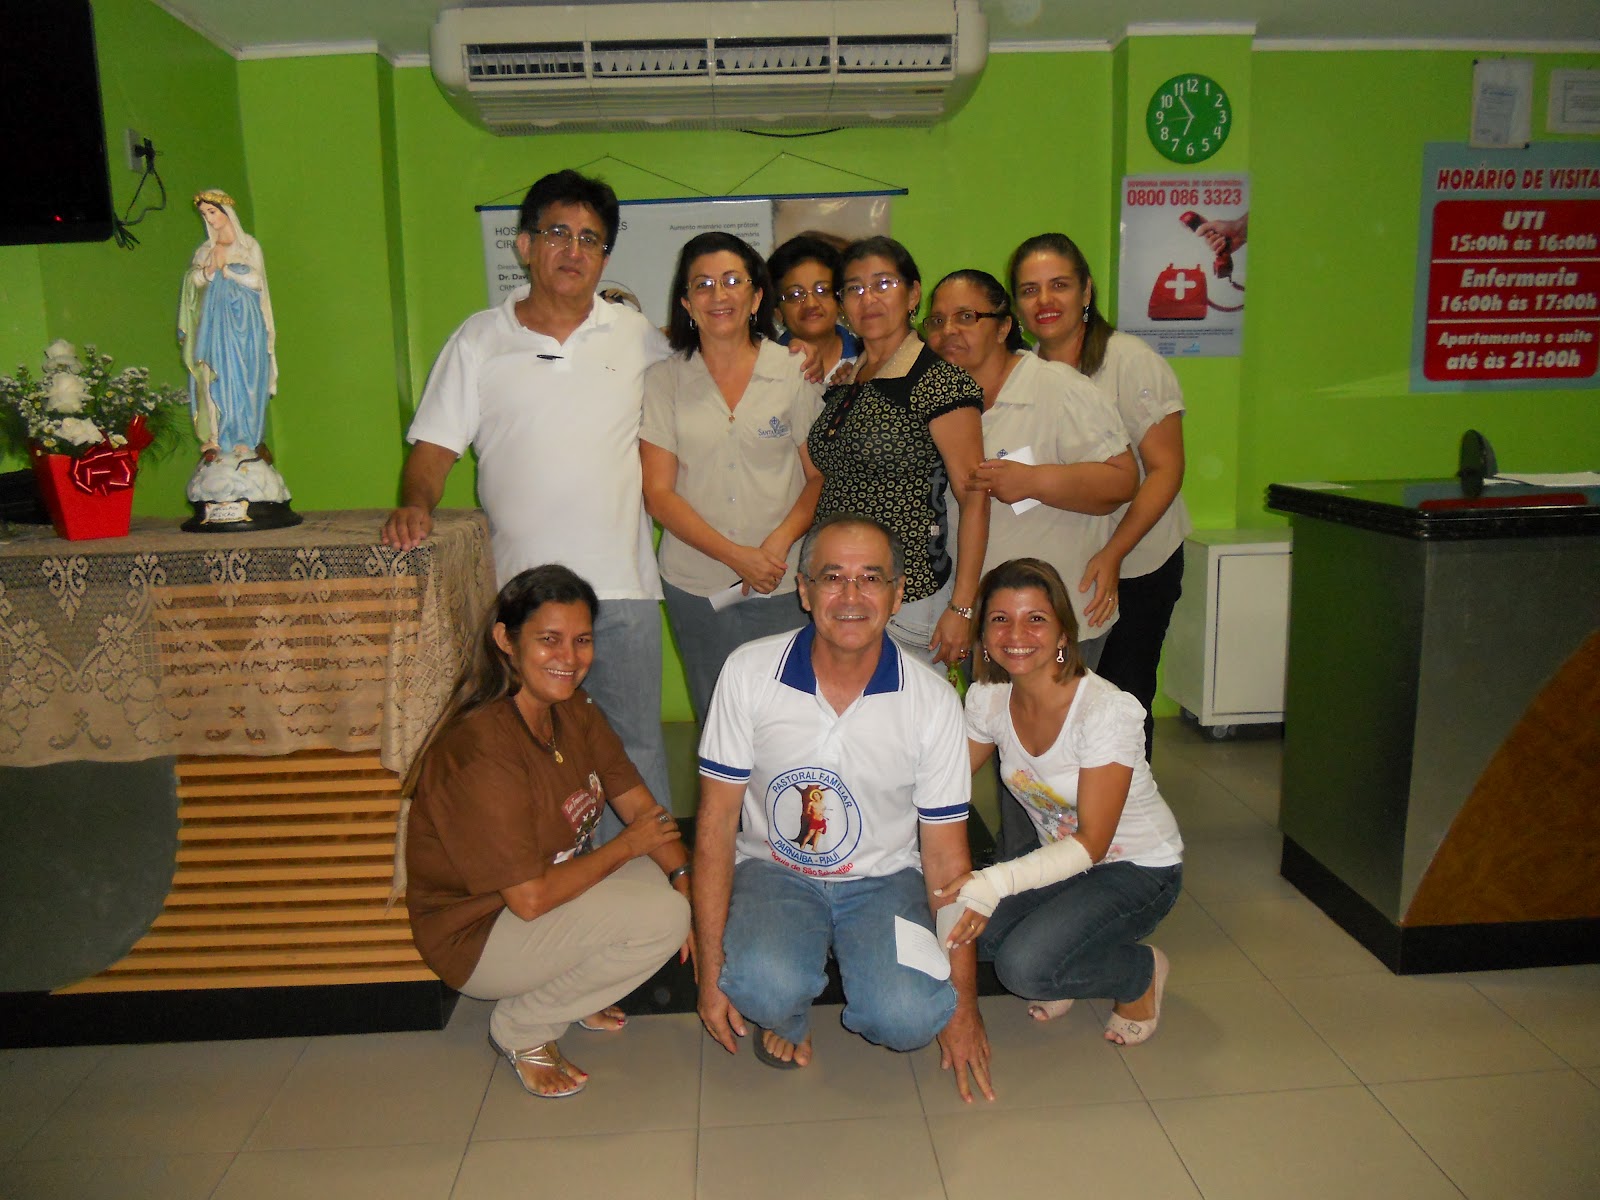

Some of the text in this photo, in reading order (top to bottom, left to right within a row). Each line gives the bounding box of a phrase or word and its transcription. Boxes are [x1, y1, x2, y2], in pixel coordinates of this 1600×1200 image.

[1174, 83, 1184, 96] 11
[1187, 79, 1199, 93] 12
[1205, 83, 1210, 96] 1
[1161, 94, 1173, 108] 10
[1214, 93, 1223, 107] 2
[1156, 111, 1164, 125] 9
[1219, 110, 1227, 124] 3
[1161, 126, 1169, 140] 8
[1213, 126, 1222, 139] 4
[1172, 138, 1180, 152] 7
[1186, 142, 1194, 156] 6
[1202, 138, 1210, 152] 5
[1436, 162, 1517, 190] HORÁRIO
[1521, 169, 1545, 190] DE
[1127, 188, 1242, 206] 0800 086 3323
[1502, 210, 1546, 230] UTI
[1450, 234, 1509, 252] 15:00h
[1539, 233, 1597, 251] 16:00h
[1460, 266, 1578, 288] Enfermaria
[1440, 294, 1502, 312] 16:00h
[1535, 293, 1597, 311] 17:00h
[1438, 331, 1541, 349] Apartamentos
[1544, 334, 1554, 343] e
[1446, 350, 1581, 370] até às 21:00h
[772, 771, 853, 808] PASTORAL FAMILIAR
[774, 839, 813, 864] PARNAÍBA
[819, 851, 840, 865] PIAUÍ
[790, 862, 801, 872] de
[802, 866, 818, 876] São
